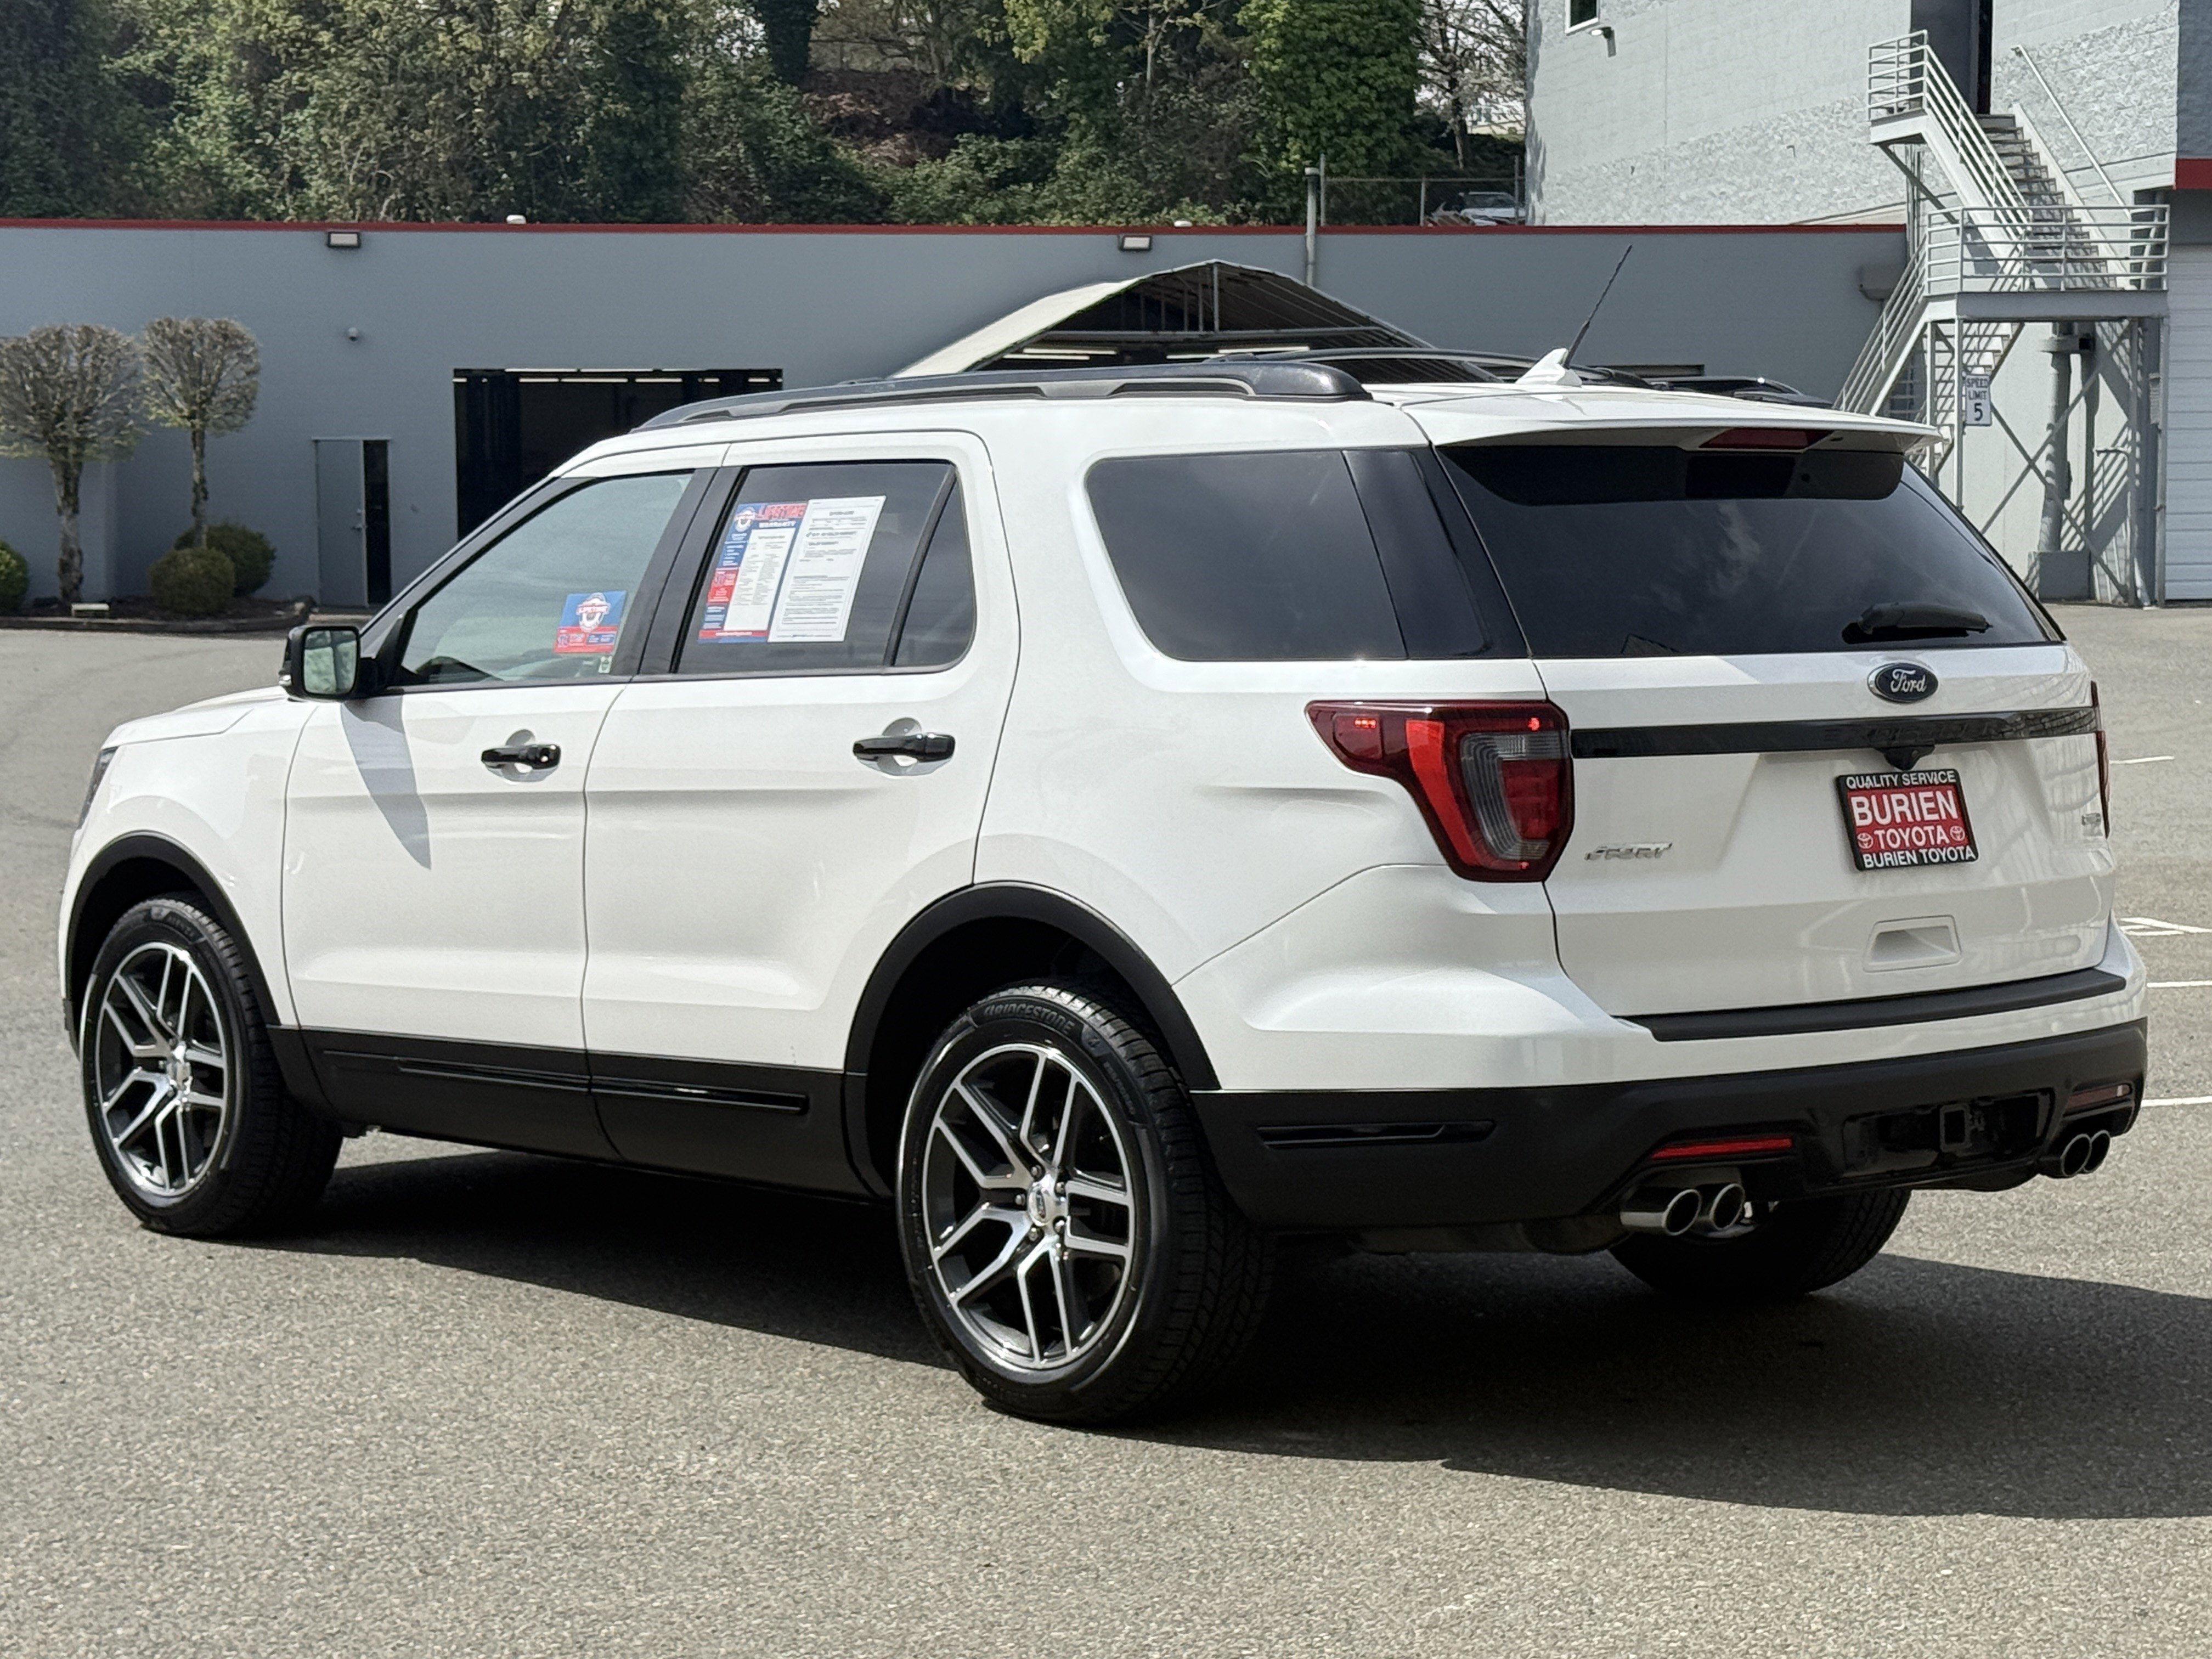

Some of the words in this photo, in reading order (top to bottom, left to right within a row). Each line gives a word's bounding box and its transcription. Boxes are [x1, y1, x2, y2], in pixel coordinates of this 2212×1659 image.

[1966, 377, 1989, 388] SPEED
[1968, 390, 1987, 400] LIMIT
[1974, 403, 1983, 421] 5
[1891, 668, 1927, 693] Ford
[1846, 774, 1898, 789] QUALITY
[1902, 770, 1956, 786] SERVICE
[1850, 789, 1959, 827] BURIEN
[1874, 825, 1950, 849] TOYOTA
[1863, 850, 1918, 868] BURIEN
[1918, 846, 1976, 864] TOYOTA
